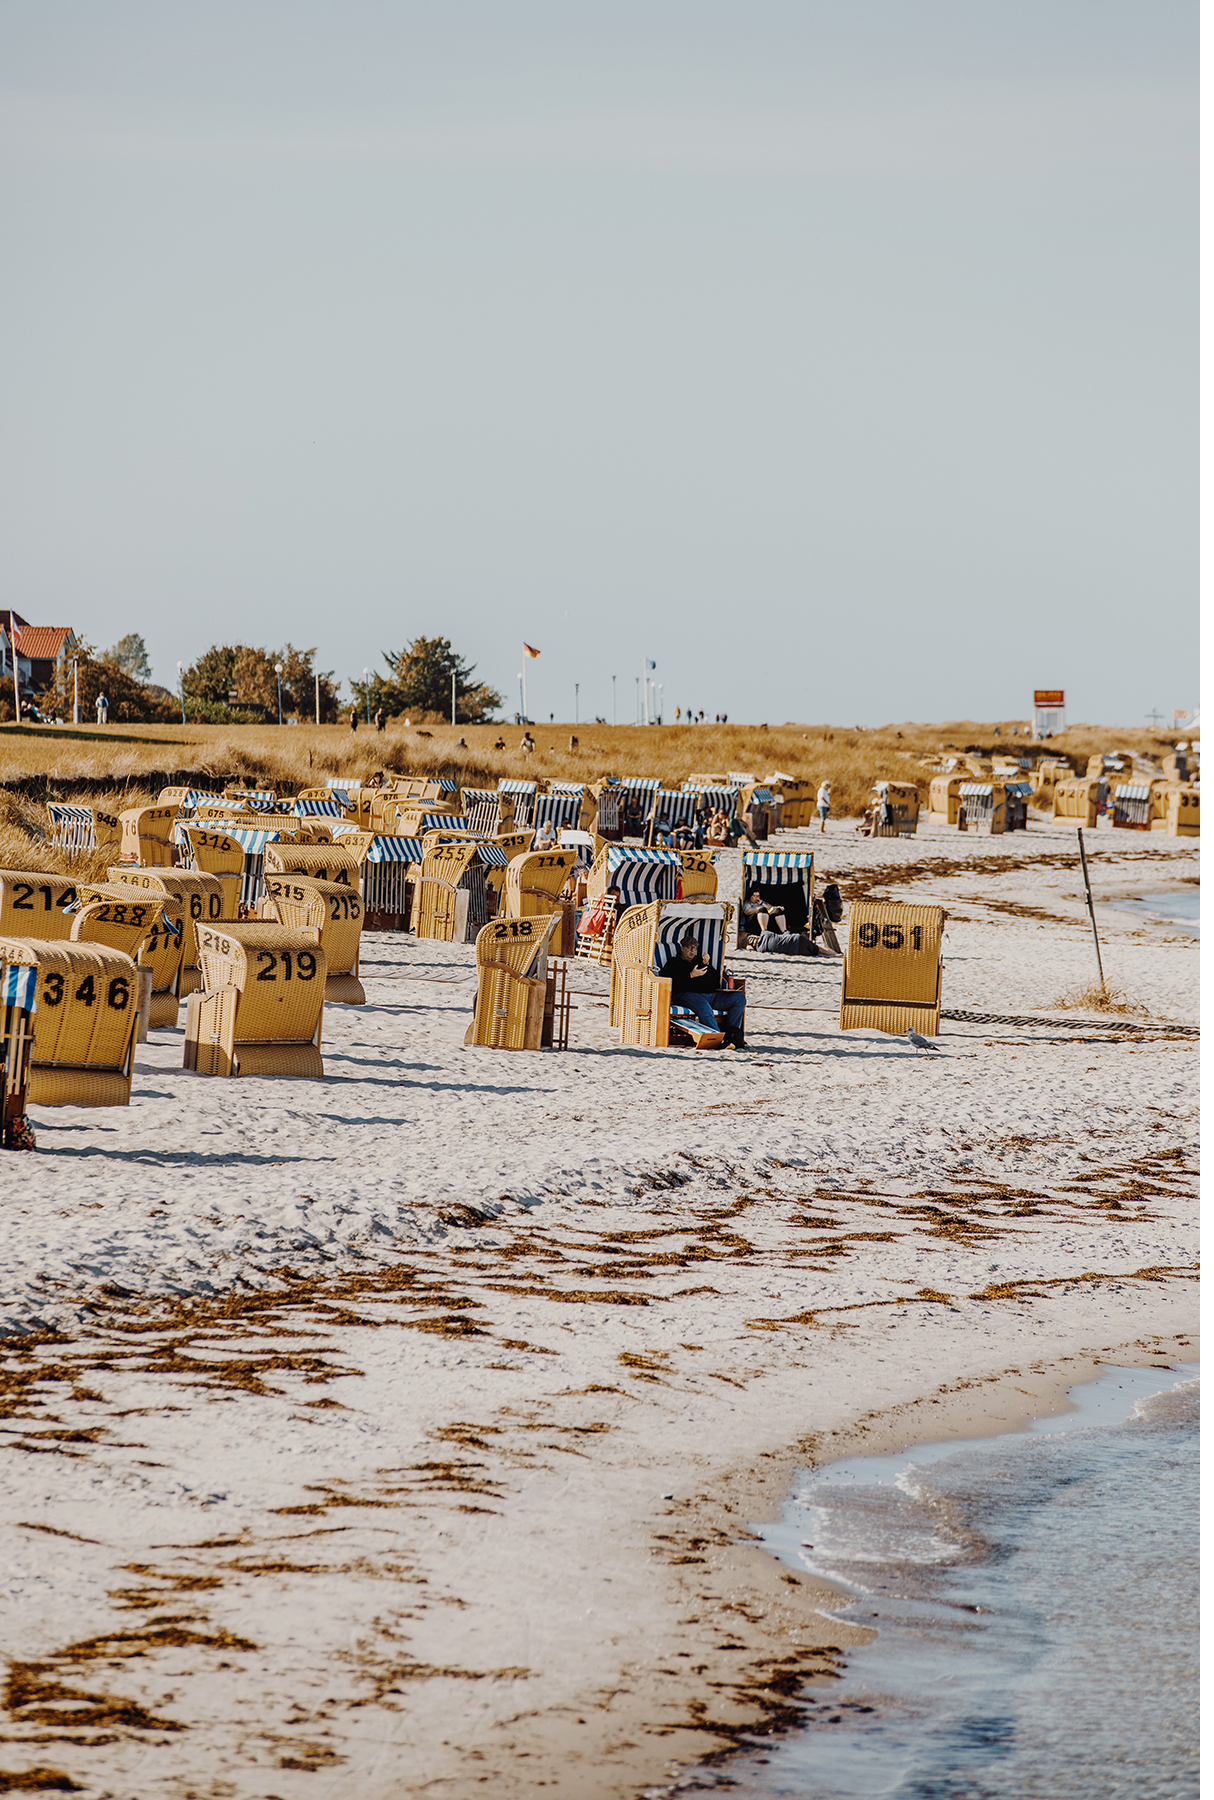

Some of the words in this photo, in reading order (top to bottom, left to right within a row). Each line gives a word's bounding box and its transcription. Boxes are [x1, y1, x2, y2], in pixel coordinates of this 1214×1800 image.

[1058, 788, 1085, 799] 927
[97, 812, 118, 828] 948
[207, 809, 224, 818] 675
[198, 831, 231, 851] 316
[344, 836, 365, 847] 632
[502, 835, 525, 847] 213
[434, 847, 466, 861] 255
[539, 857, 565, 868] 774
[13, 883, 76, 911] 214
[270, 882, 305, 901] 215
[95, 904, 146, 927] 288
[330, 895, 361, 920] 215
[628, 910, 649, 930] 684
[495, 922, 532, 938] 218
[858, 922, 923, 951] 951
[256, 951, 317, 981] 219
[43, 972, 130, 1010] 346
